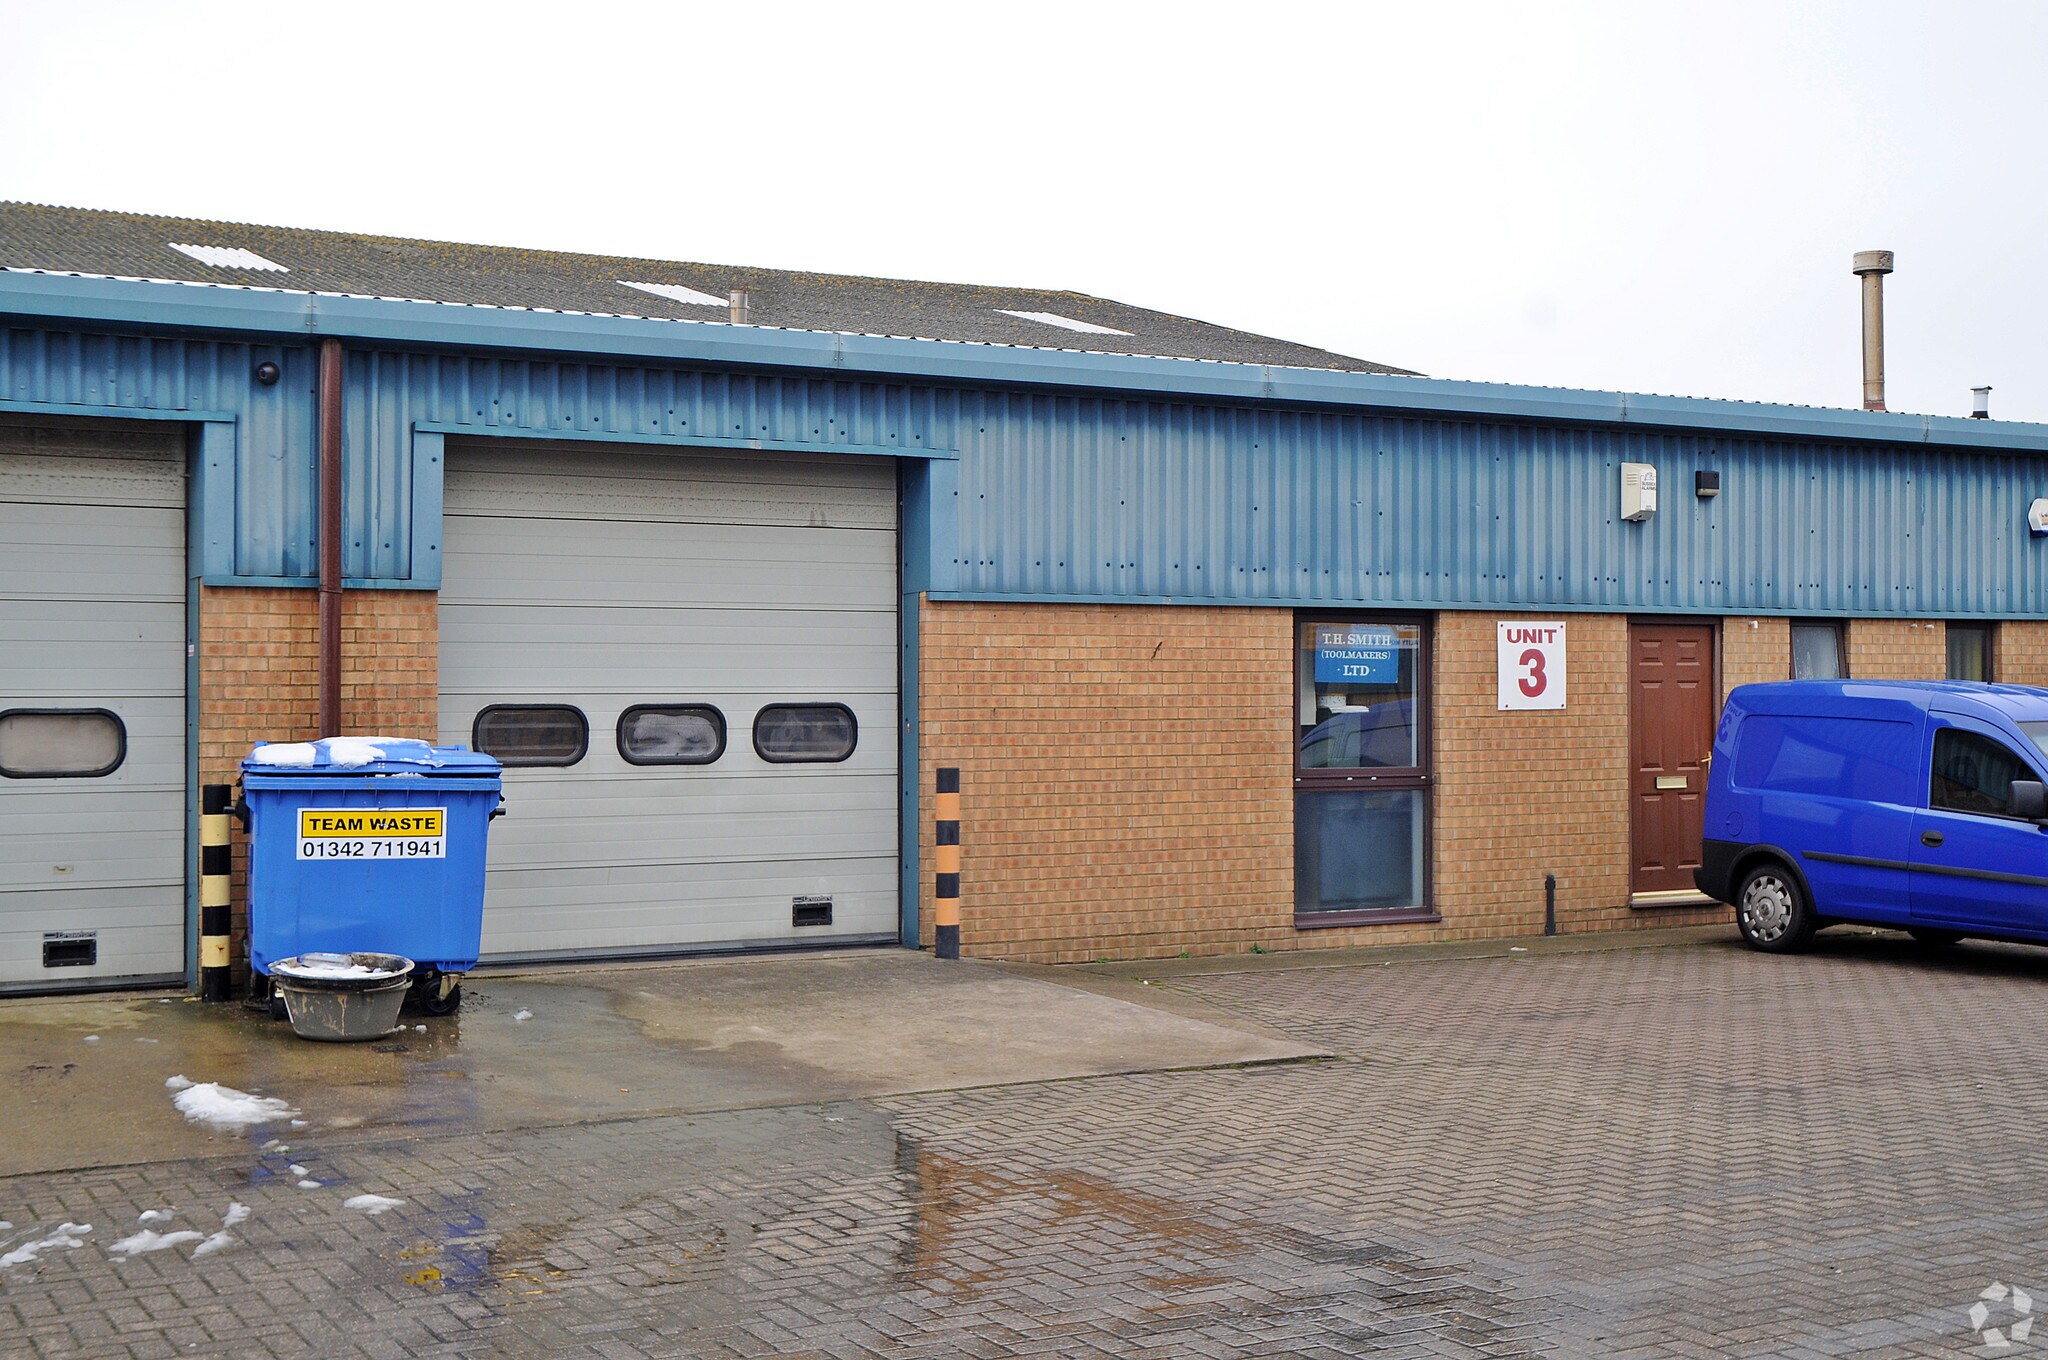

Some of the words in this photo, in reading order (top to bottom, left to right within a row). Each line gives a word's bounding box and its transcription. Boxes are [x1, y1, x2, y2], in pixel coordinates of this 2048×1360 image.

[1322, 633, 1345, 645] T.H.
[1347, 633, 1391, 646] SMITH
[1506, 628, 1557, 644] UNIT
[1321, 649, 1391, 660] (TOOLMAKERS)
[1342, 664, 1370, 676] LTD
[1518, 648, 1547, 698] 3
[309, 818, 363, 831] TEAM
[369, 817, 436, 830] WASTE
[303, 841, 364, 857] 01342
[371, 840, 441, 857] 711941
